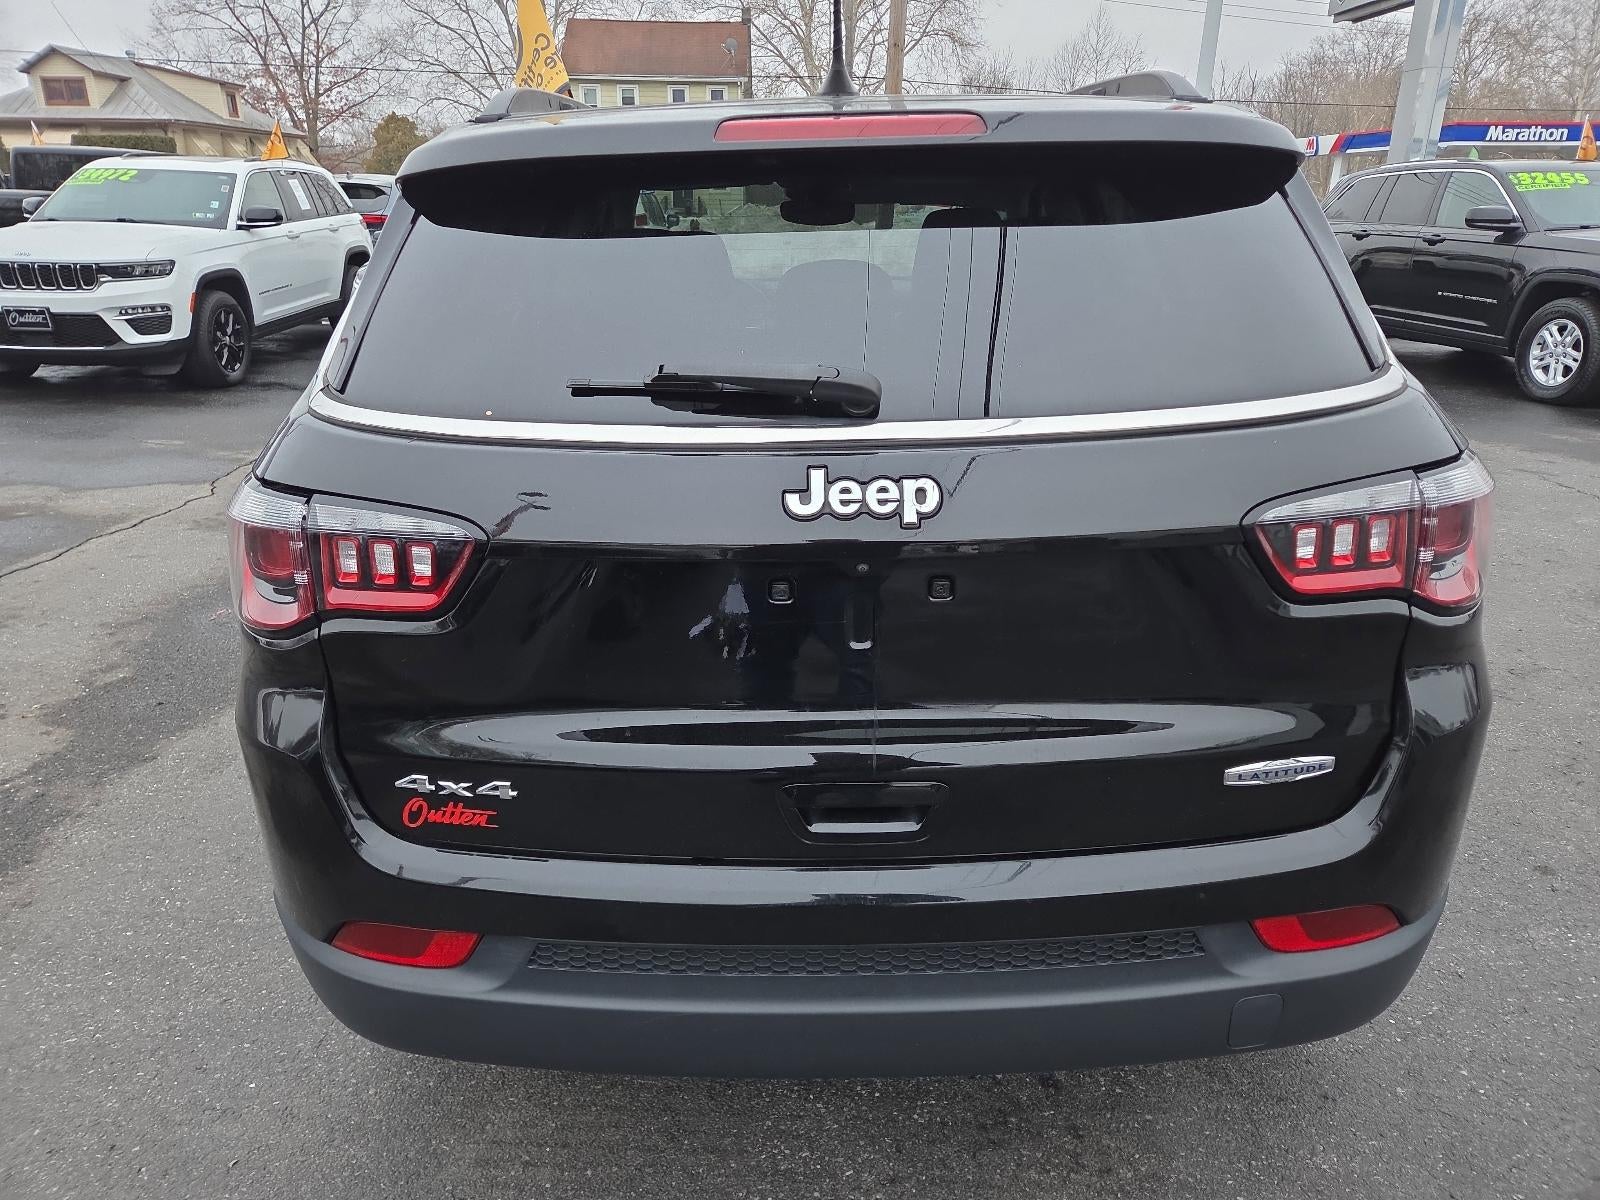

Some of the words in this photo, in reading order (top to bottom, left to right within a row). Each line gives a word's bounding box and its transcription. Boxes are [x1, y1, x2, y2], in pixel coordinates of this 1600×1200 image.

[1485, 125, 1568, 141] Marathon
[9, 311, 47, 325] Outten
[783, 465, 942, 528] Jeep
[1238, 763, 1328, 781] LATITUDE
[395, 774, 518, 799] 4x4
[402, 797, 499, 828] Outten
